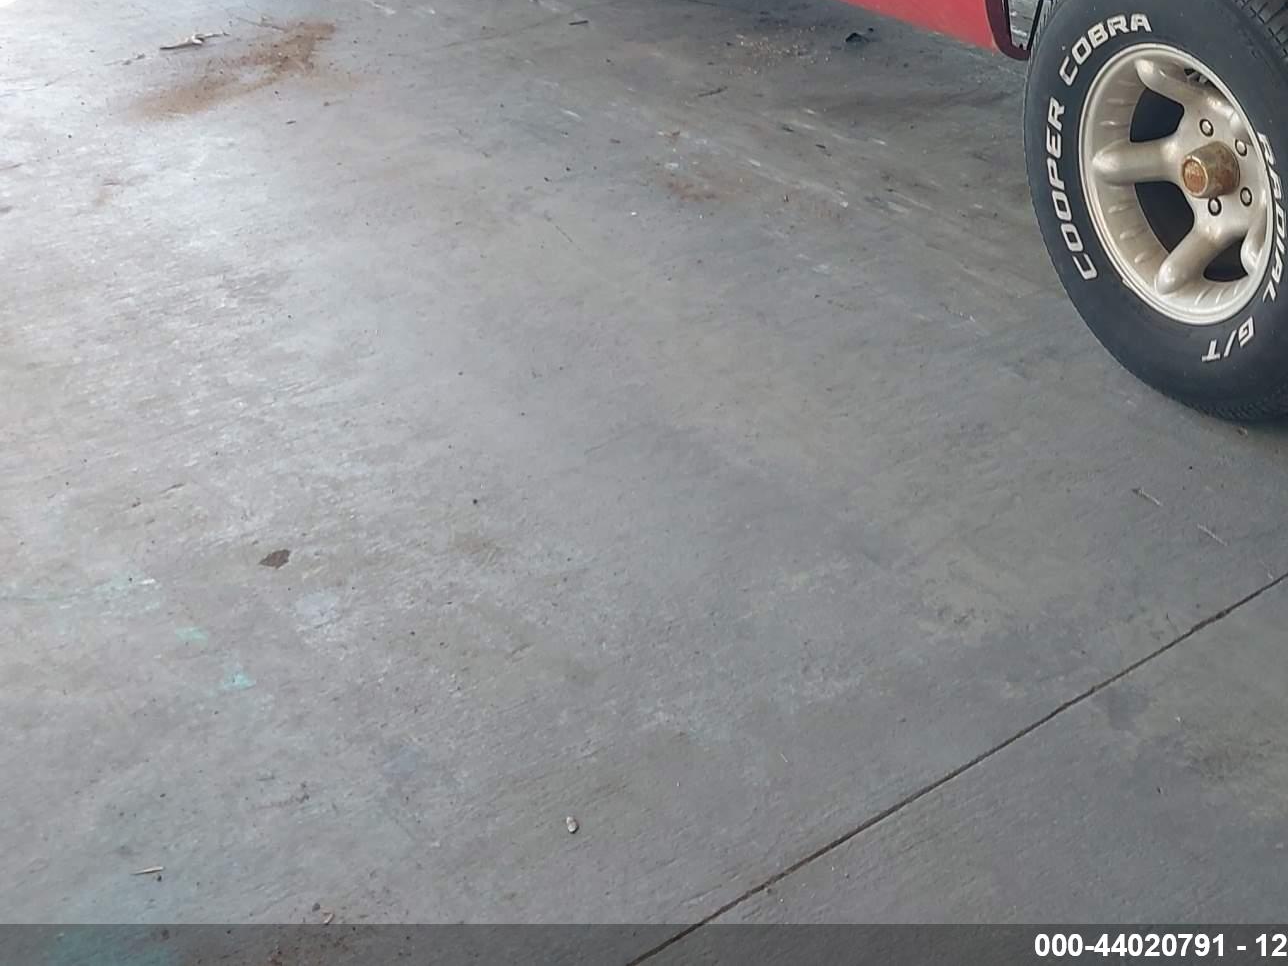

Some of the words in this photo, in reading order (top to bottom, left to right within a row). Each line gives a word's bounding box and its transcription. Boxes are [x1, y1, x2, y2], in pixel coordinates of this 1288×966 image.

[1058, 13, 1153, 87] COBRA
[1045, 97, 1098, 281] COOPER
[1257, 131, 1288, 303] RADIAL
[1201, 316, 1255, 363] G/T
